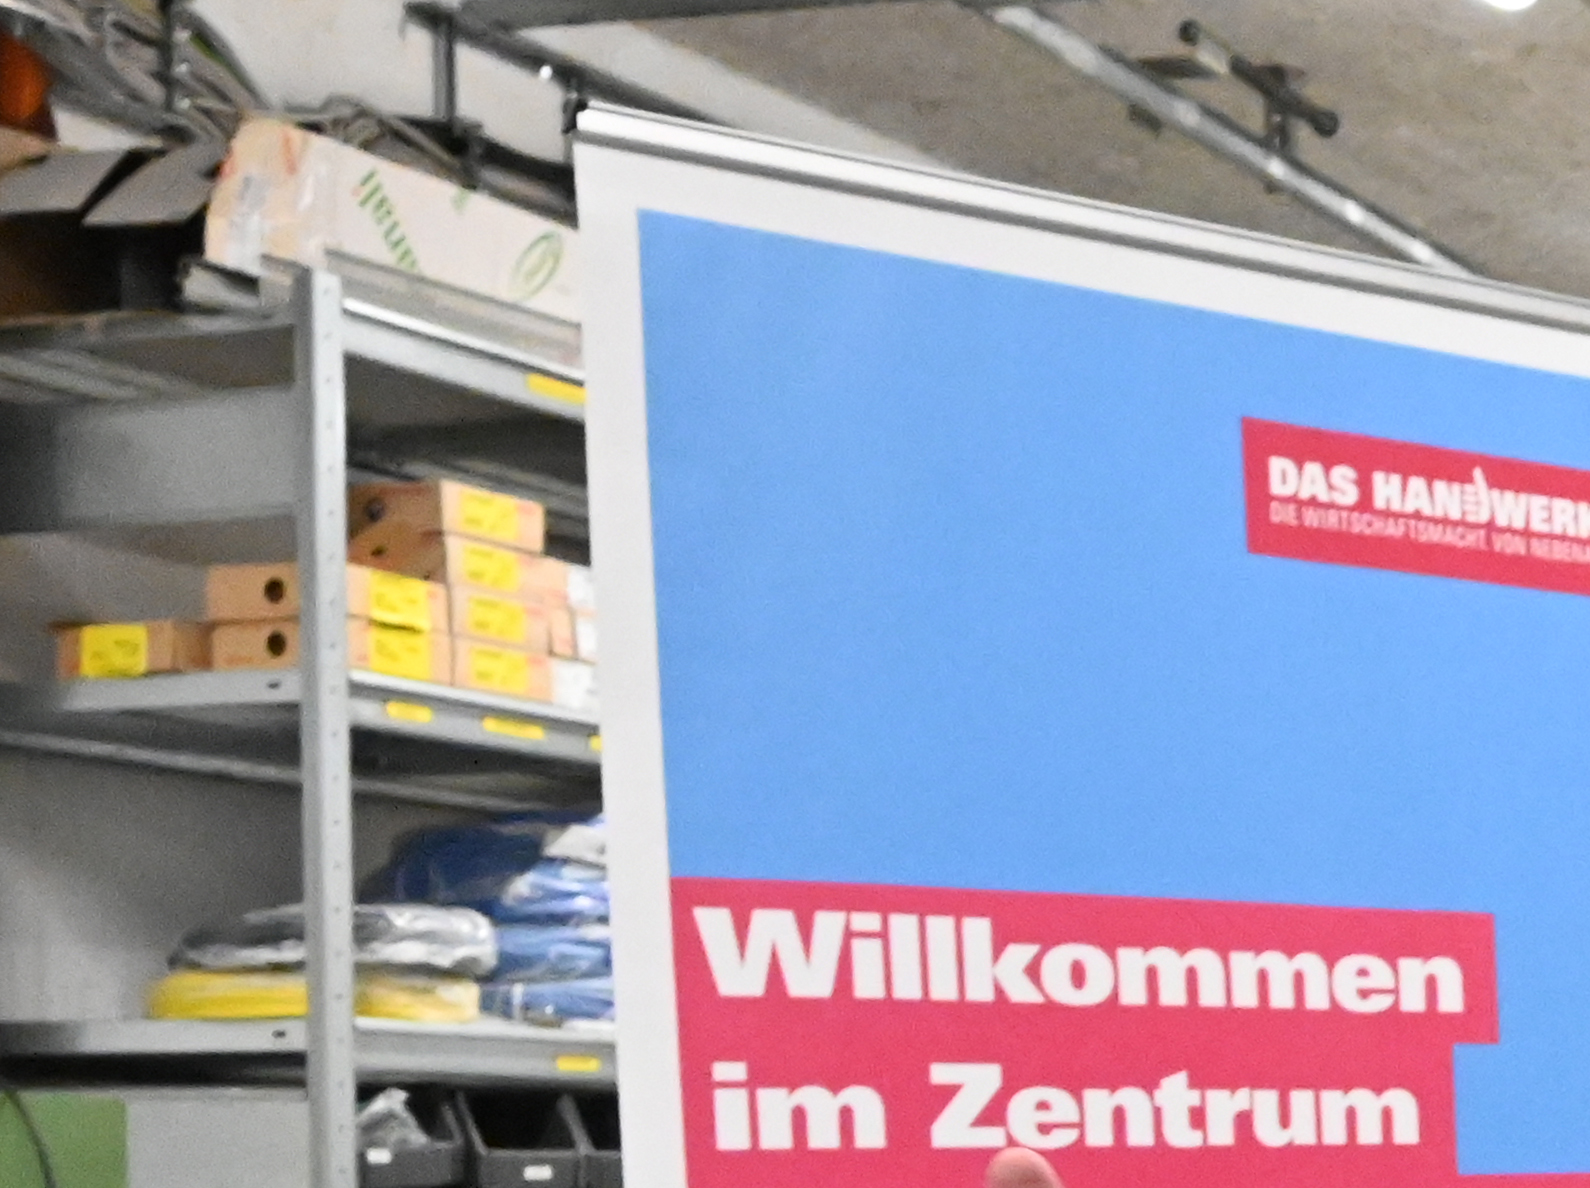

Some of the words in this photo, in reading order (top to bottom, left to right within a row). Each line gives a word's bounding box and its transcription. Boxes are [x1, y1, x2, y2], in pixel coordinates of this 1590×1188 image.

[1267, 454, 1361, 507] DAS
[1268, 499, 1299, 527] DIE
[1491, 530, 1528, 556] VON
[692, 905, 1466, 1015] Willkommen
[710, 1060, 888, 1151] im
[928, 1061, 1421, 1151] Zentrum
